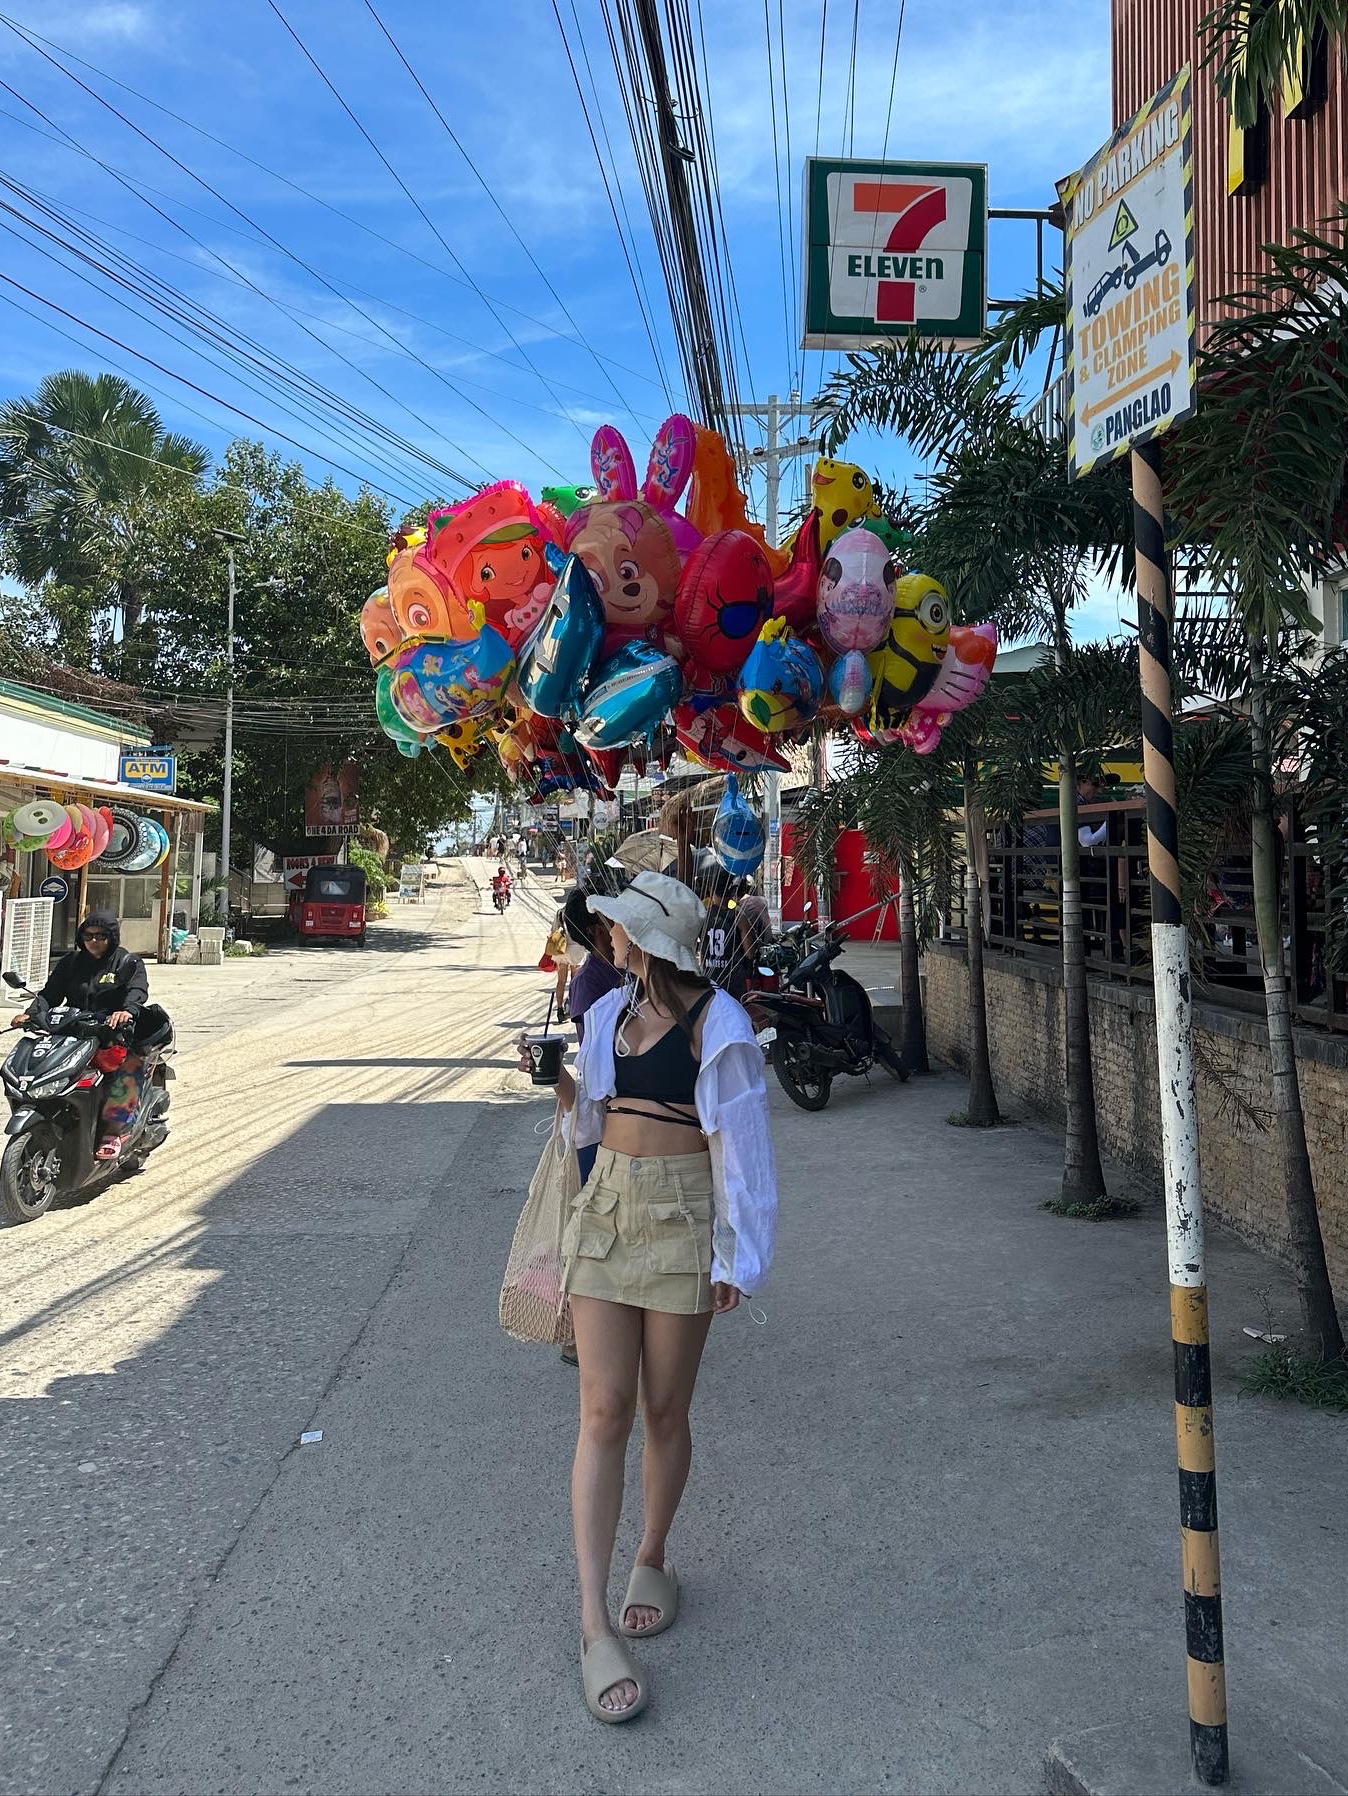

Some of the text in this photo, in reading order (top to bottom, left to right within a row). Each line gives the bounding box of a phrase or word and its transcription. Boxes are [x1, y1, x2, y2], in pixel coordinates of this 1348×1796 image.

[1073, 100, 1179, 232] NO PARKING
[847, 254, 944, 280] ELEVEn
[1078, 262, 1180, 361] TOWING
[1079, 299, 1181, 385] & CLAMPING
[1107, 346, 1148, 390] ZONE
[1105, 382, 1171, 446] PANGLAO
[128, 763, 166, 773] ATM
[327, 826, 336, 834] DA
[338, 825, 359, 834] ROAD
[707, 928, 725, 957] 13
